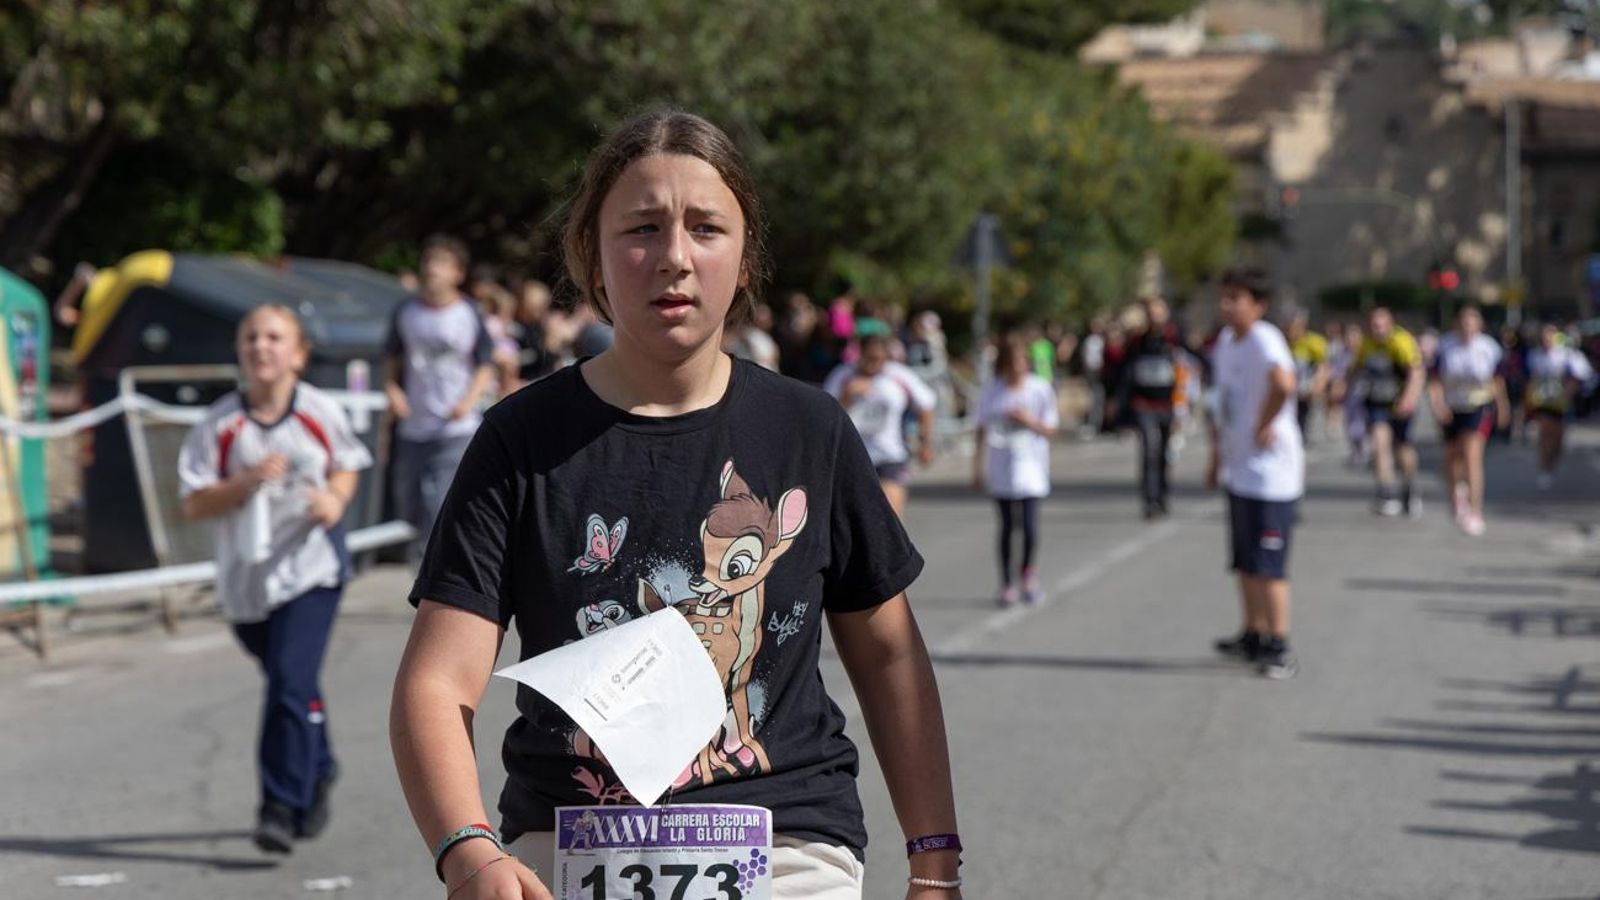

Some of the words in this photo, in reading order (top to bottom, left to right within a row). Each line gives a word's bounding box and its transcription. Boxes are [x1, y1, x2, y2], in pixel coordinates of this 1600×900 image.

[591, 814, 659, 843] XXXVI
[661, 814, 709, 827] CARRERA
[712, 813, 760, 827] ESCOLAR
[670, 828, 686, 842] LA
[697, 828, 746, 842] GLORIA
[581, 863, 743, 900] 1373
